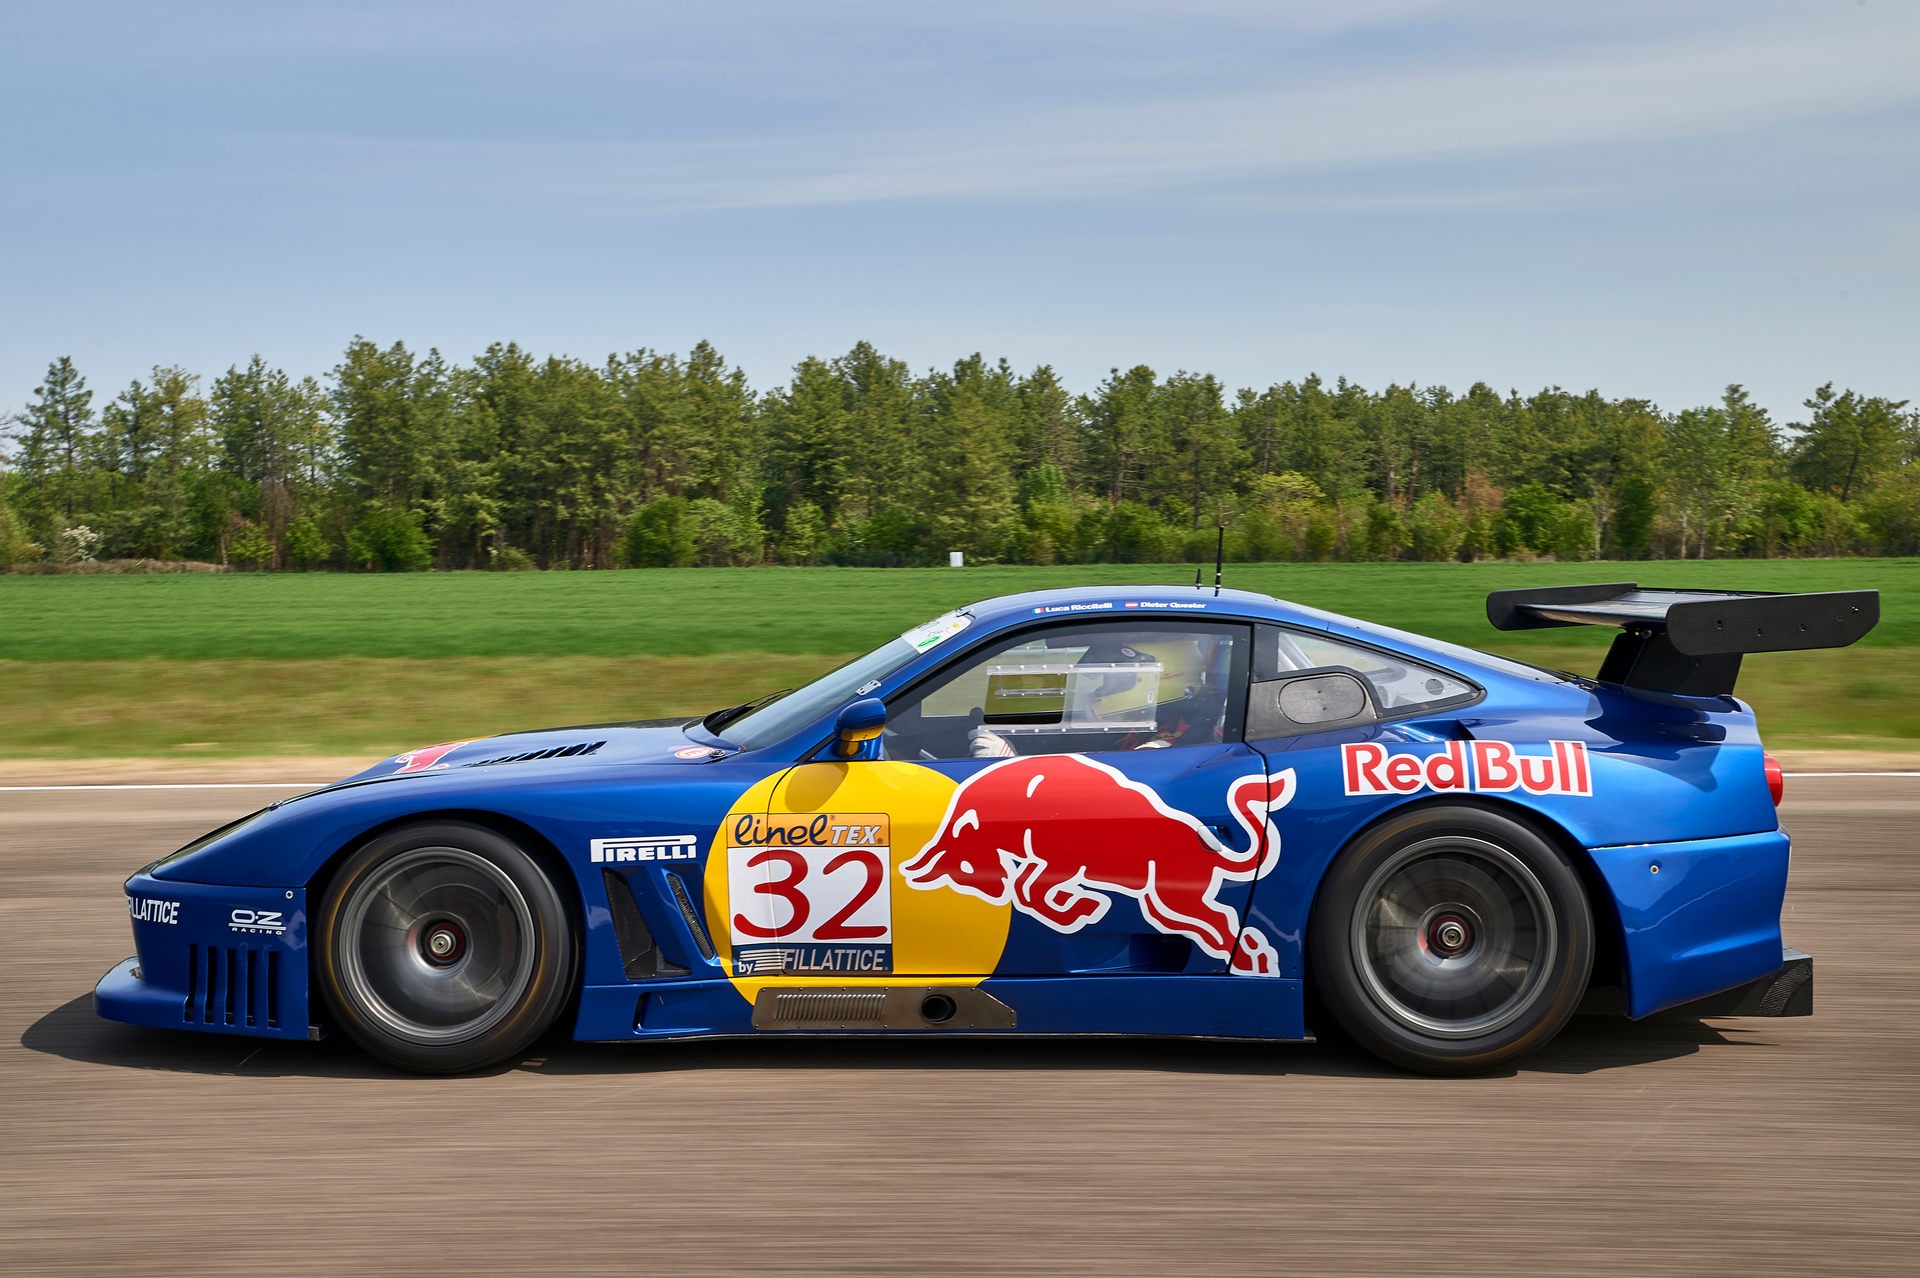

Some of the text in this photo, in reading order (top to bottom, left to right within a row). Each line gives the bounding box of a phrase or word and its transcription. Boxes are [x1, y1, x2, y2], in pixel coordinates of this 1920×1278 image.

[1140, 601, 1169, 609] Dieter
[1344, 740, 1589, 794] Red Bull
[590, 834, 697, 863] PIRELLI
[831, 825, 881, 845] TEX
[733, 849, 888, 940] 32
[231, 927, 283, 935] RACING
[738, 949, 886, 976] by FILLATTICE
